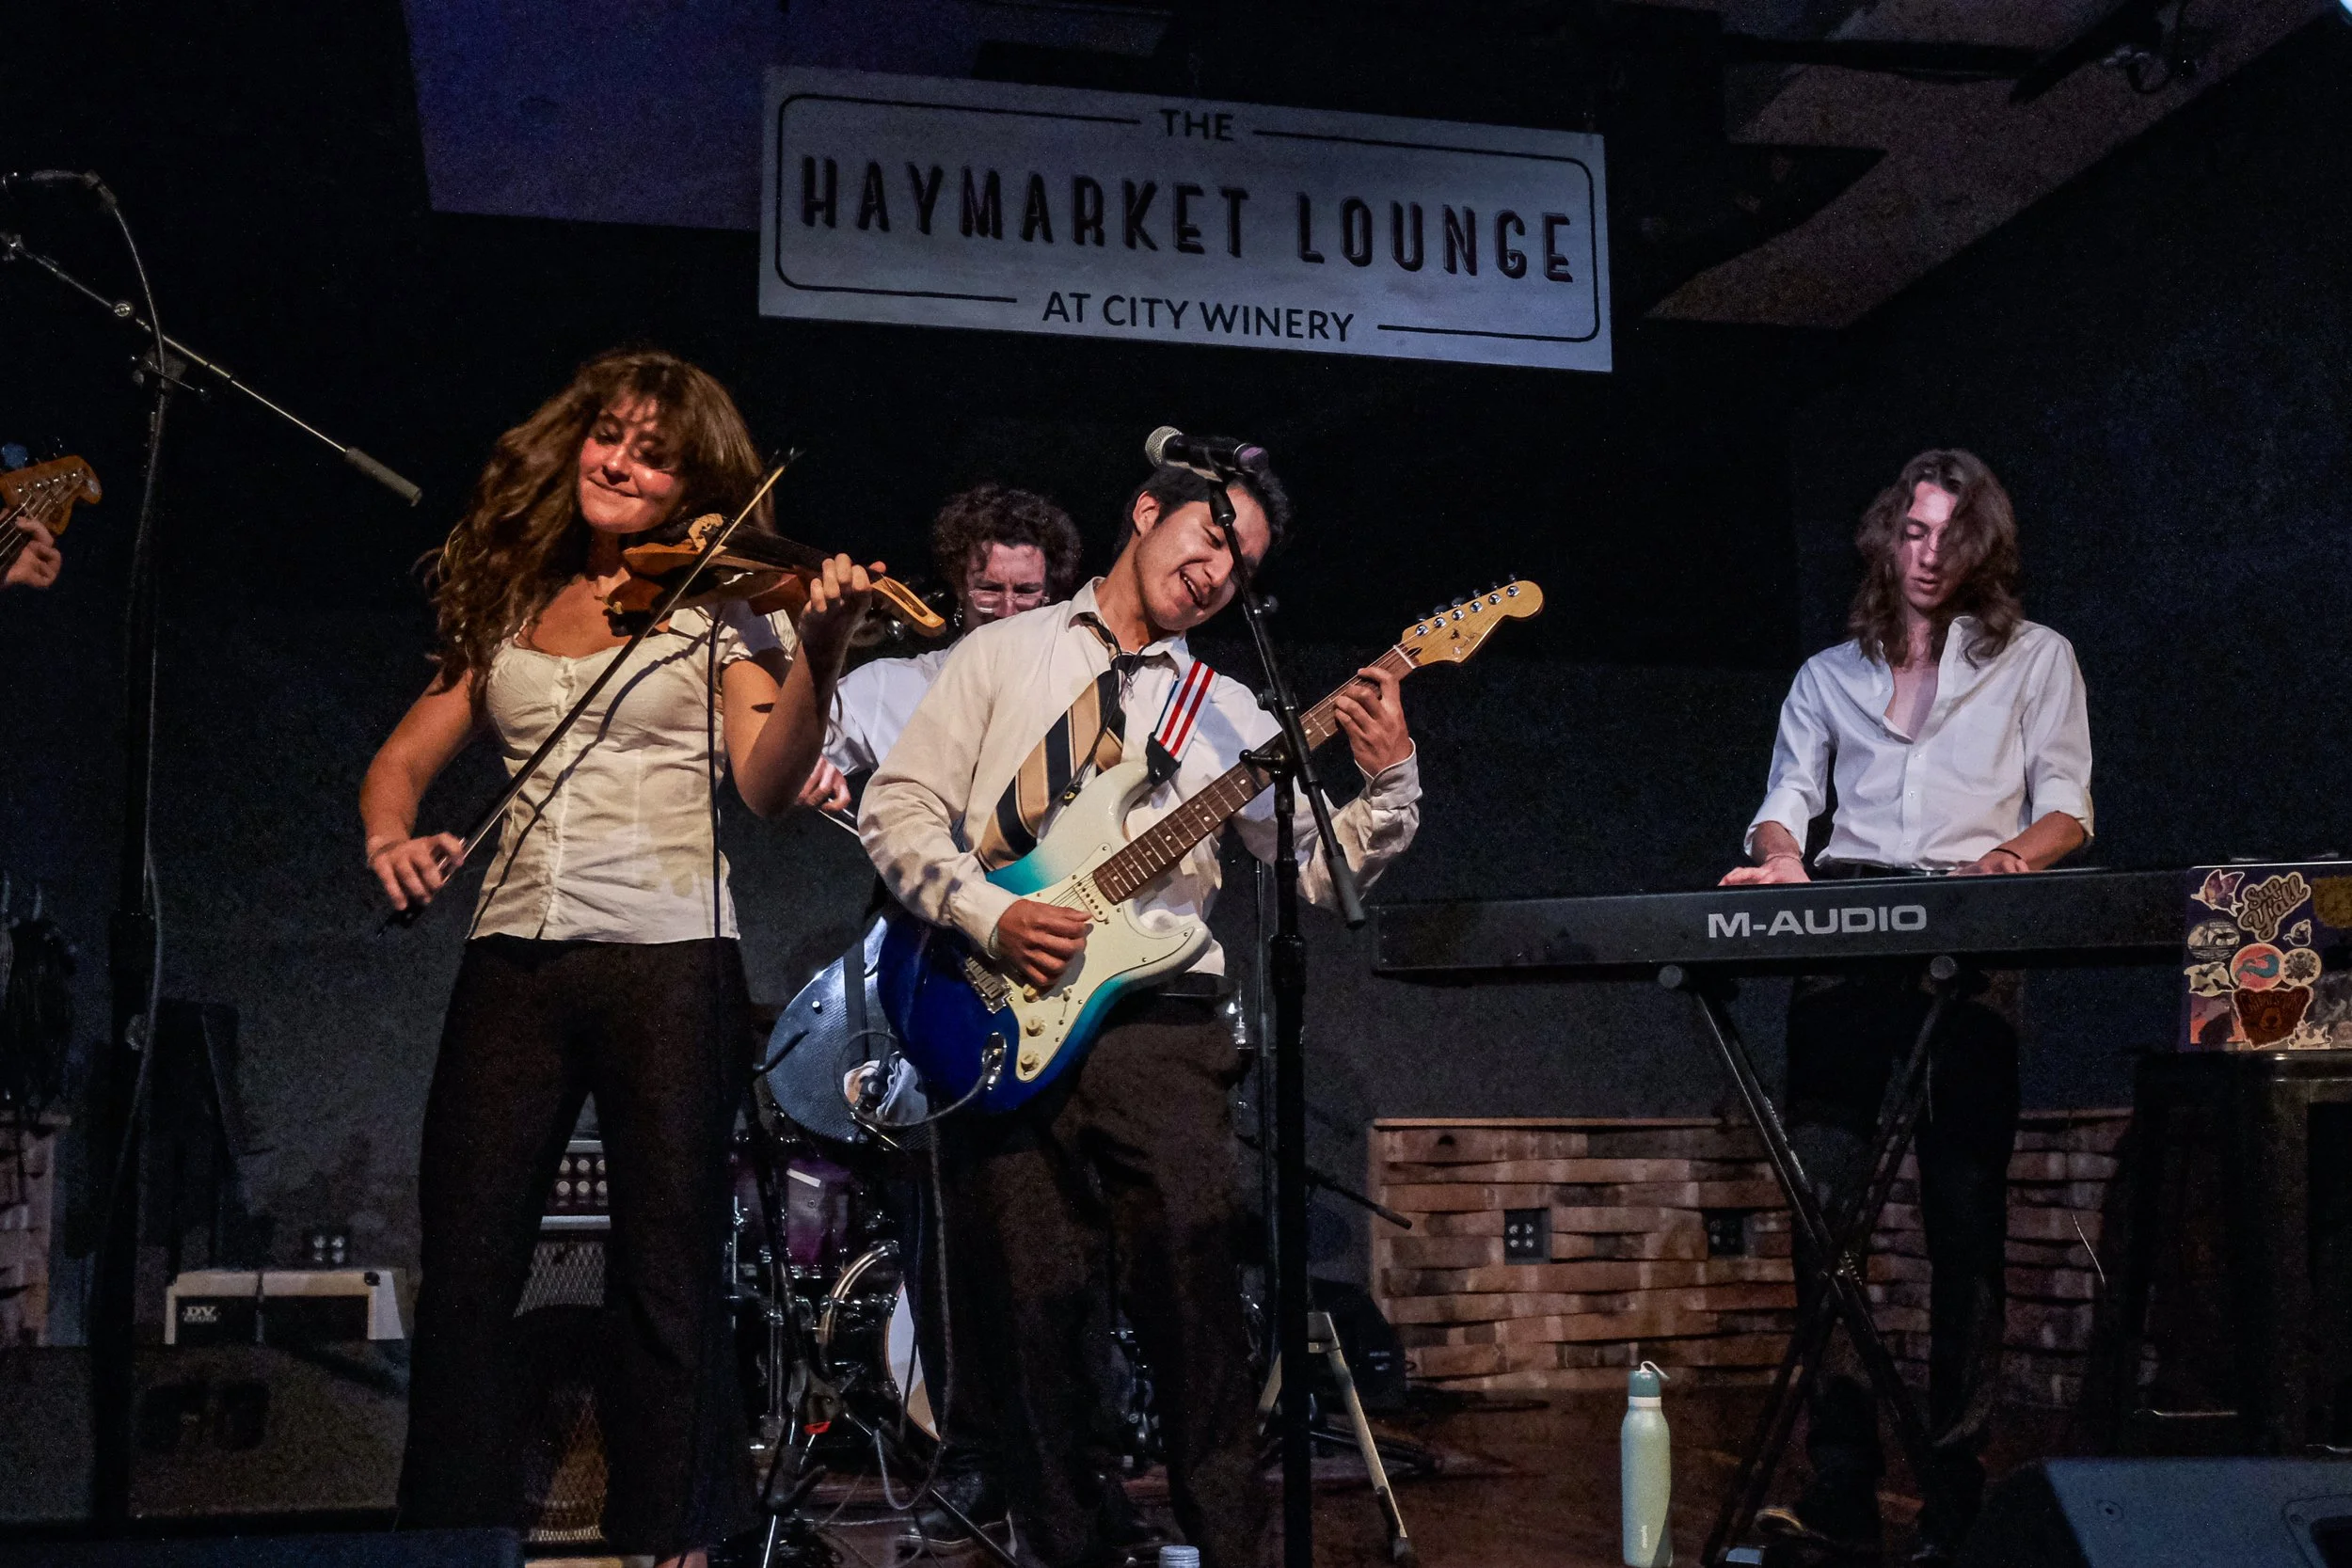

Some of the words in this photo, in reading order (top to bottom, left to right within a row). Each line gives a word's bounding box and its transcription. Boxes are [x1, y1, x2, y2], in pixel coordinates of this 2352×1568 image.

[1160, 108, 1234, 141] THE
[800, 154, 1250, 259] HAYMARKET
[1296, 190, 1574, 284] LOUNGE
[1042, 292, 1091, 324] AT
[1103, 294, 1188, 330] CITY
[1199, 301, 1355, 341] WINERY
[2245, 878, 2280, 911] Sup
[1708, 905, 1927, 938] M-AUDIO
